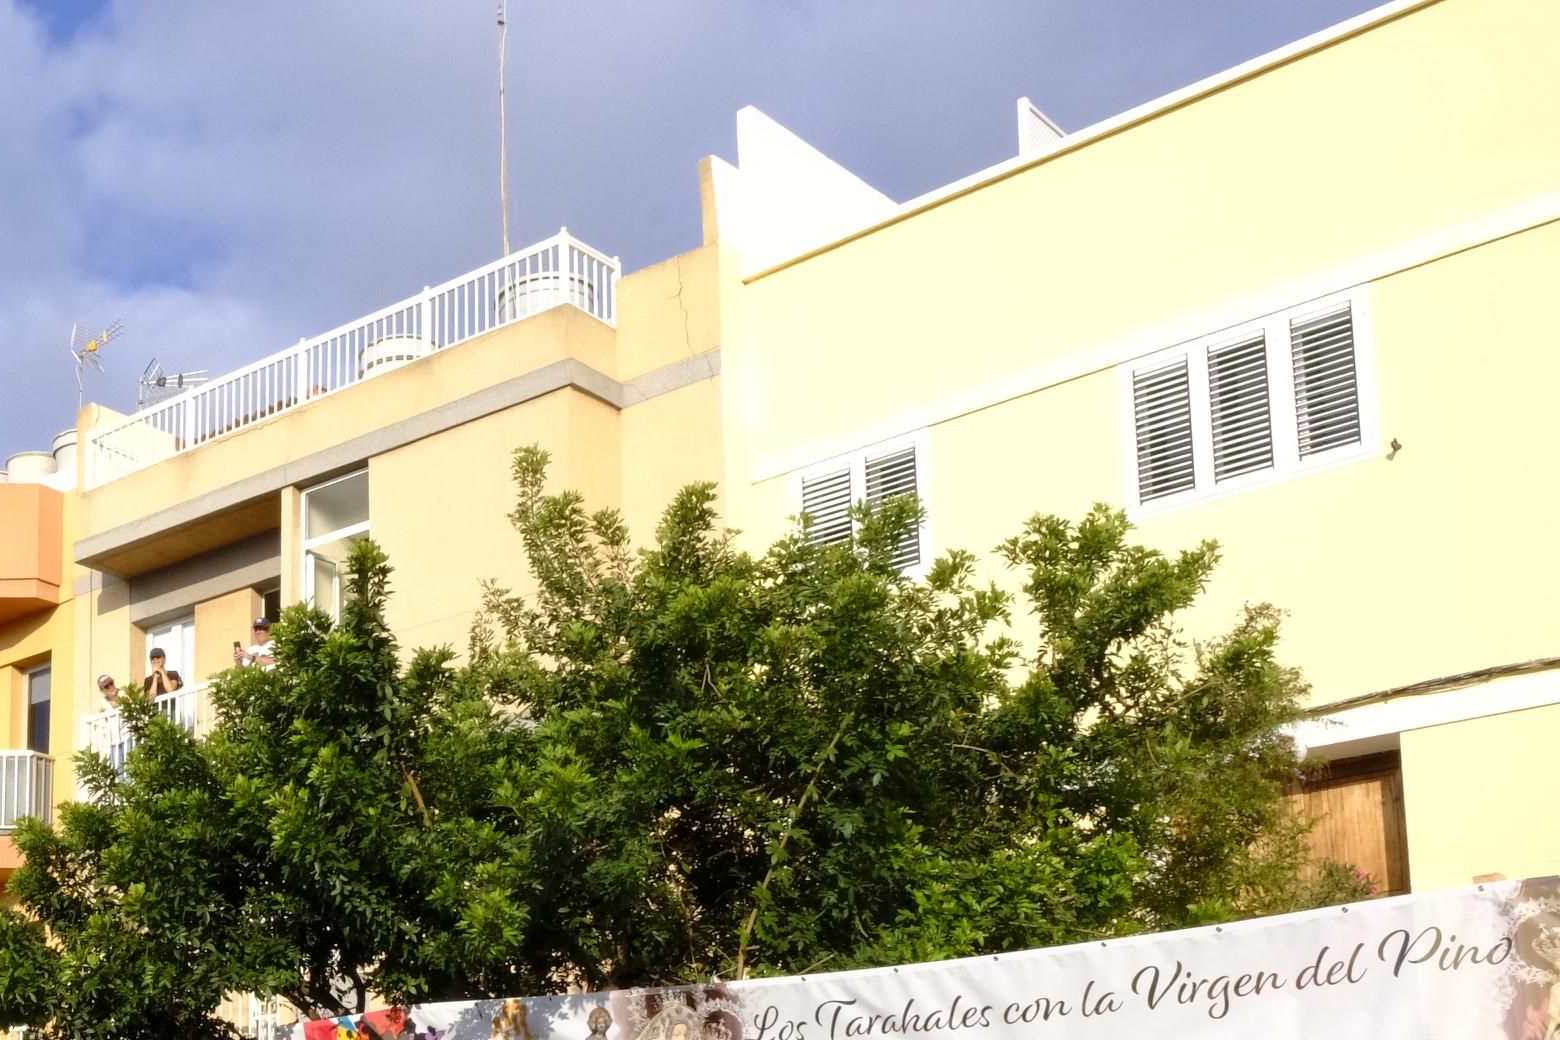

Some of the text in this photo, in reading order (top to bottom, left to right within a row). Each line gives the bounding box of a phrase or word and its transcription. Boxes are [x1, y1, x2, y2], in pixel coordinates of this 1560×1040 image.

[1003, 996, 1072, 1025] con
[1081, 980, 1124, 1018] la
[1131, 959, 1287, 1020] Virgen
[1295, 945, 1367, 988] del
[1377, 925, 1513, 979] Pino
